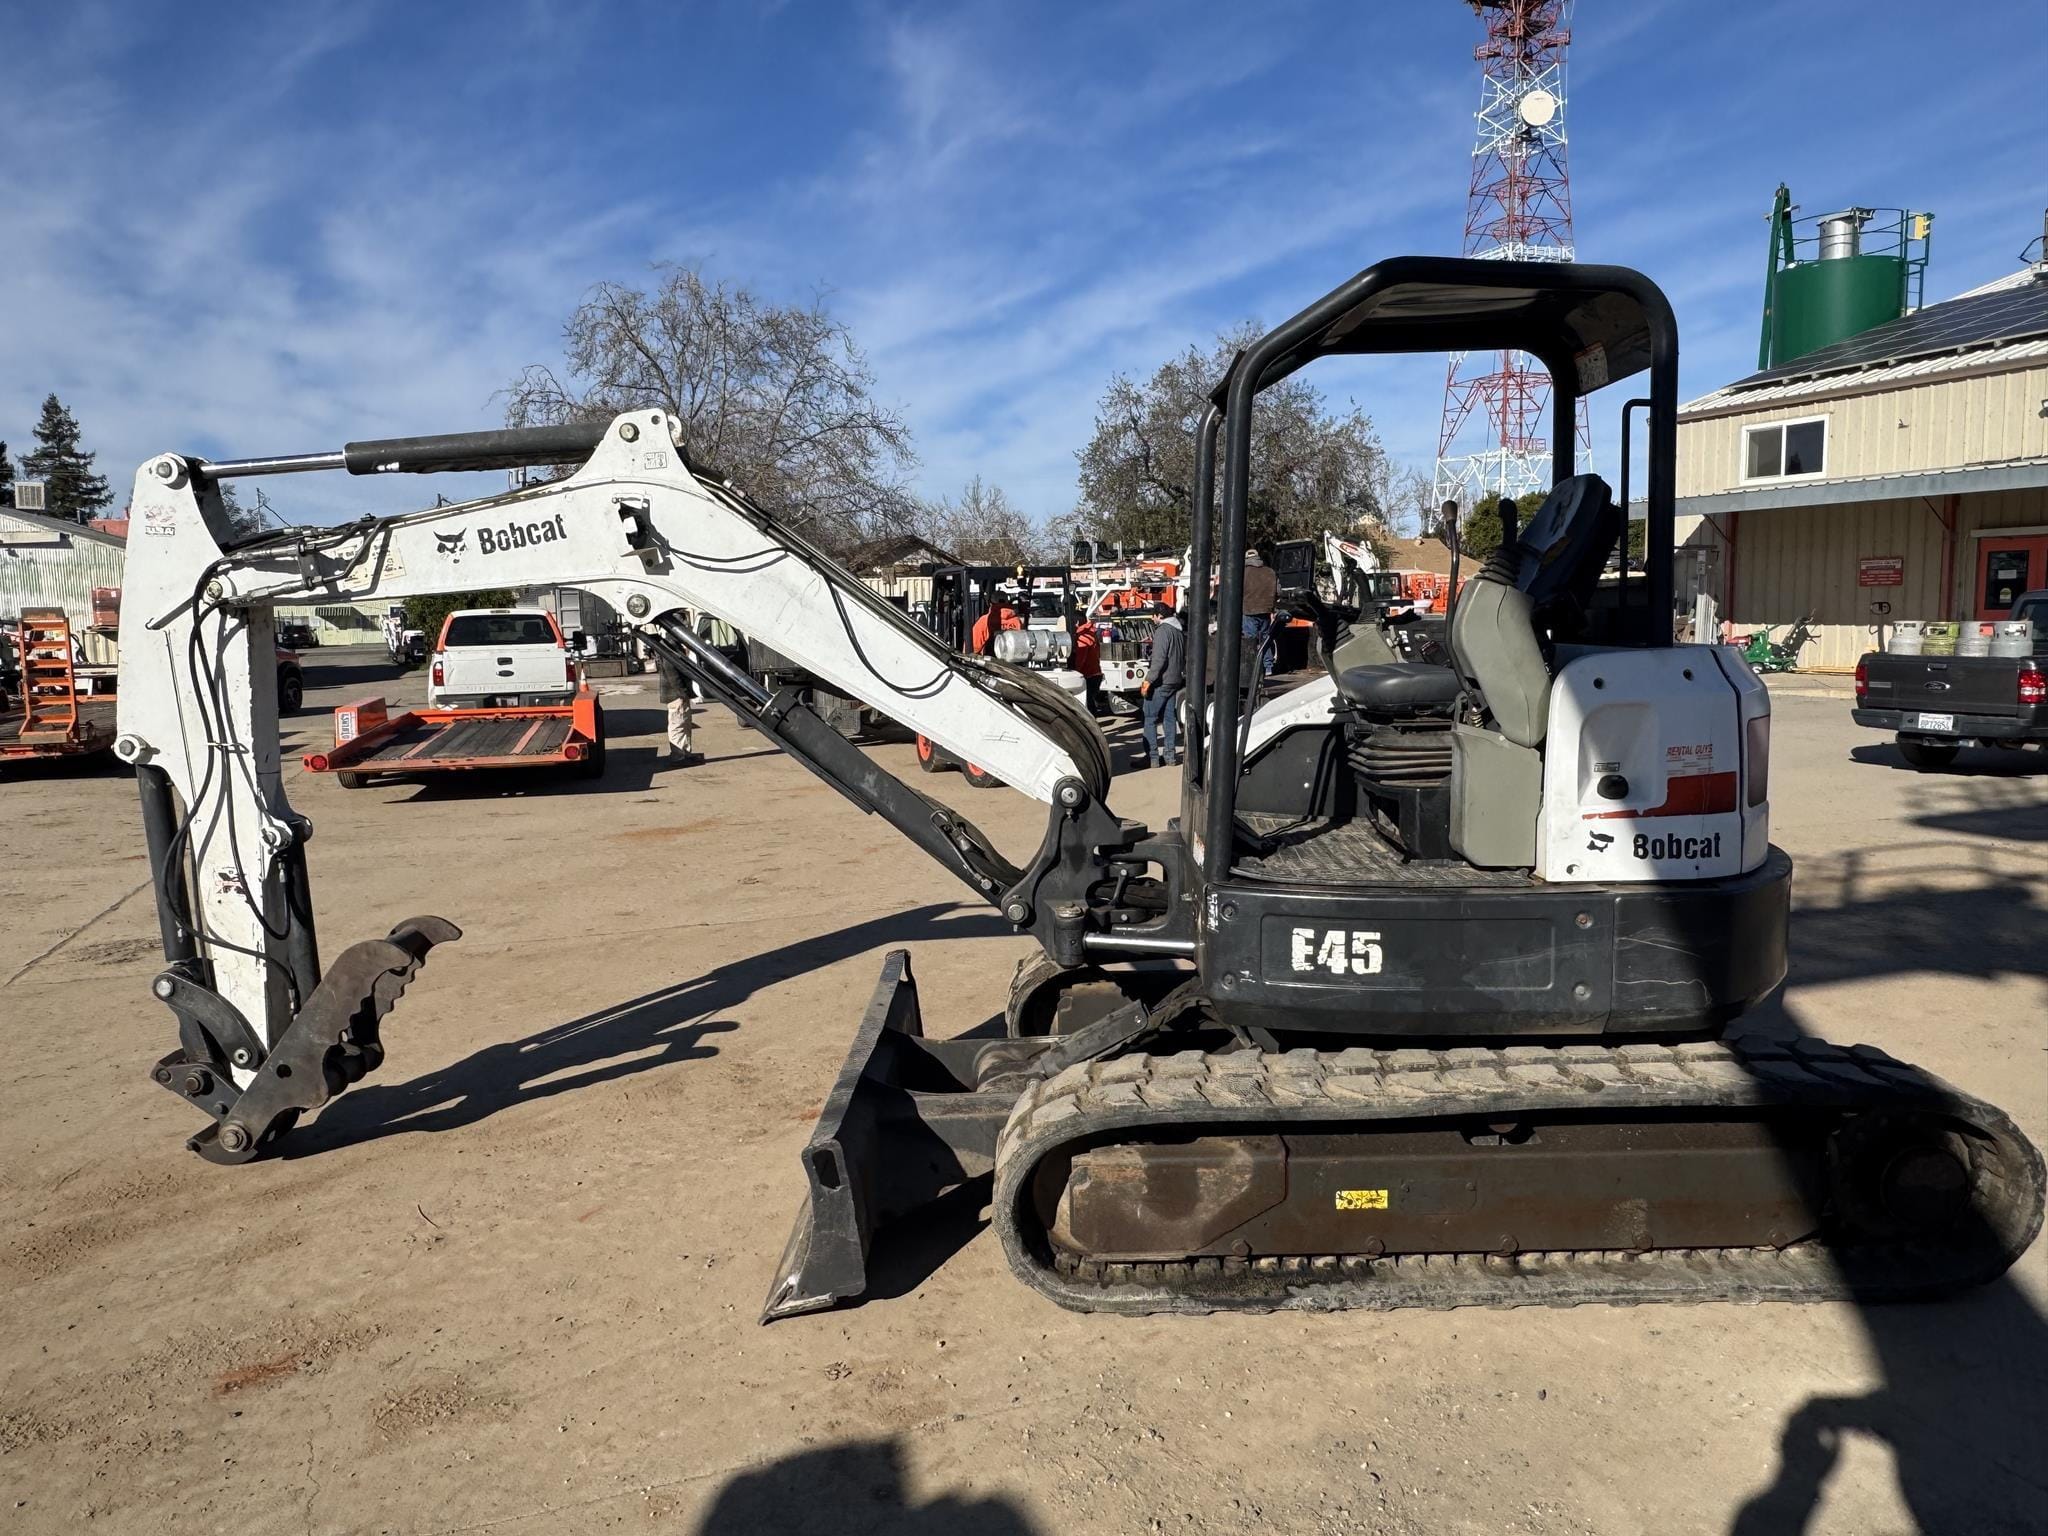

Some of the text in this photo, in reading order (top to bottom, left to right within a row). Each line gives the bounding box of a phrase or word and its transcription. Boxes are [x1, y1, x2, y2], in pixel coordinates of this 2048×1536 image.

[477, 513, 568, 555] Bobcat
[1633, 832, 1721, 860] Bobcat
[1291, 927, 1383, 975] E45
